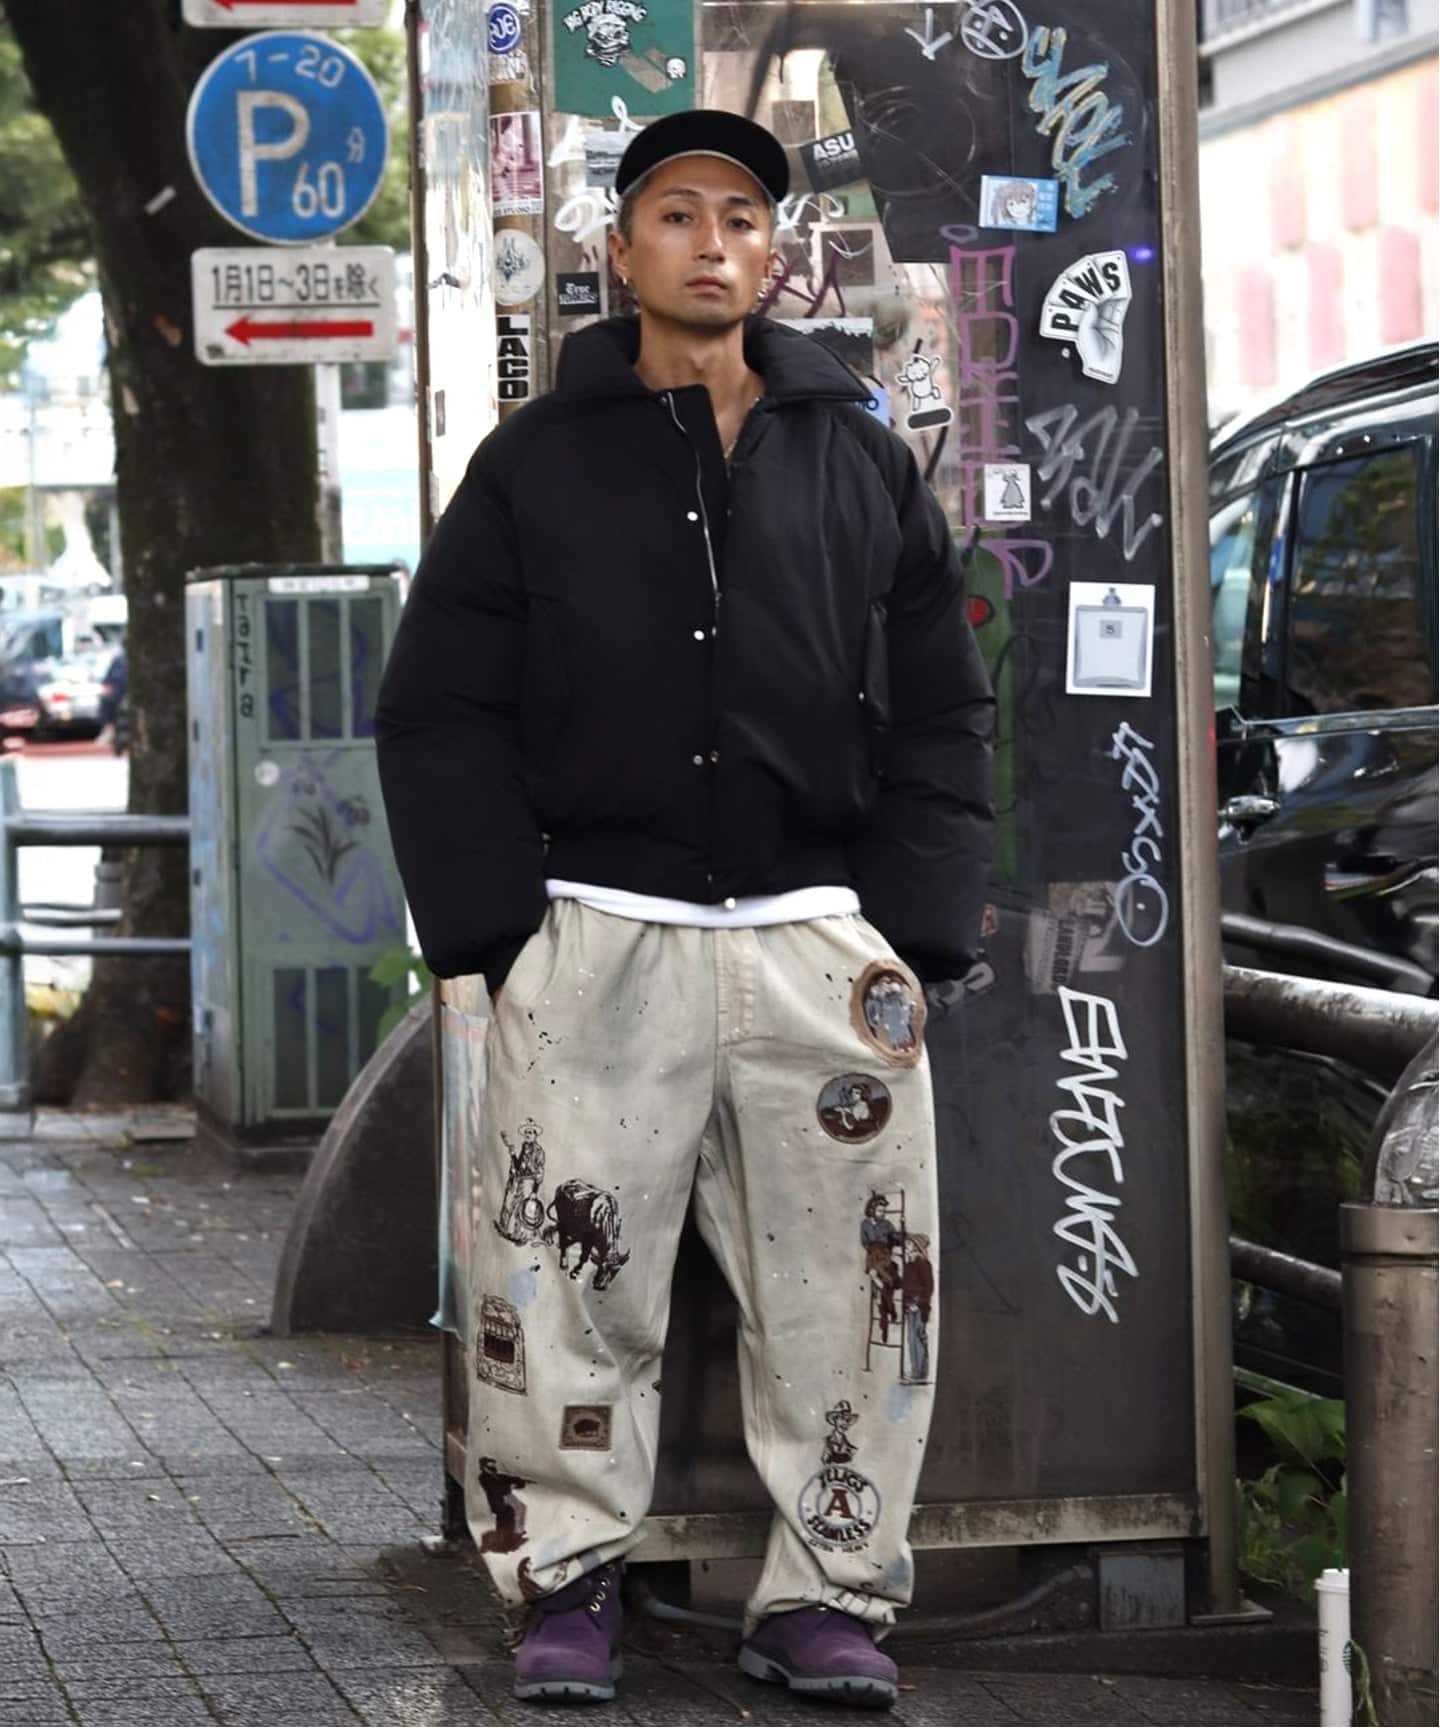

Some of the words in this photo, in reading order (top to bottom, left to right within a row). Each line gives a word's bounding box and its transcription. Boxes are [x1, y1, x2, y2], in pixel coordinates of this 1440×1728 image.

[236, 89, 311, 218] P
[812, 133, 855, 161] ASU
[292, 161, 346, 219] 60
[1050, 261, 1121, 332] PAWS
[497, 316, 529, 400] LACO
[824, 1488, 857, 1519] A
